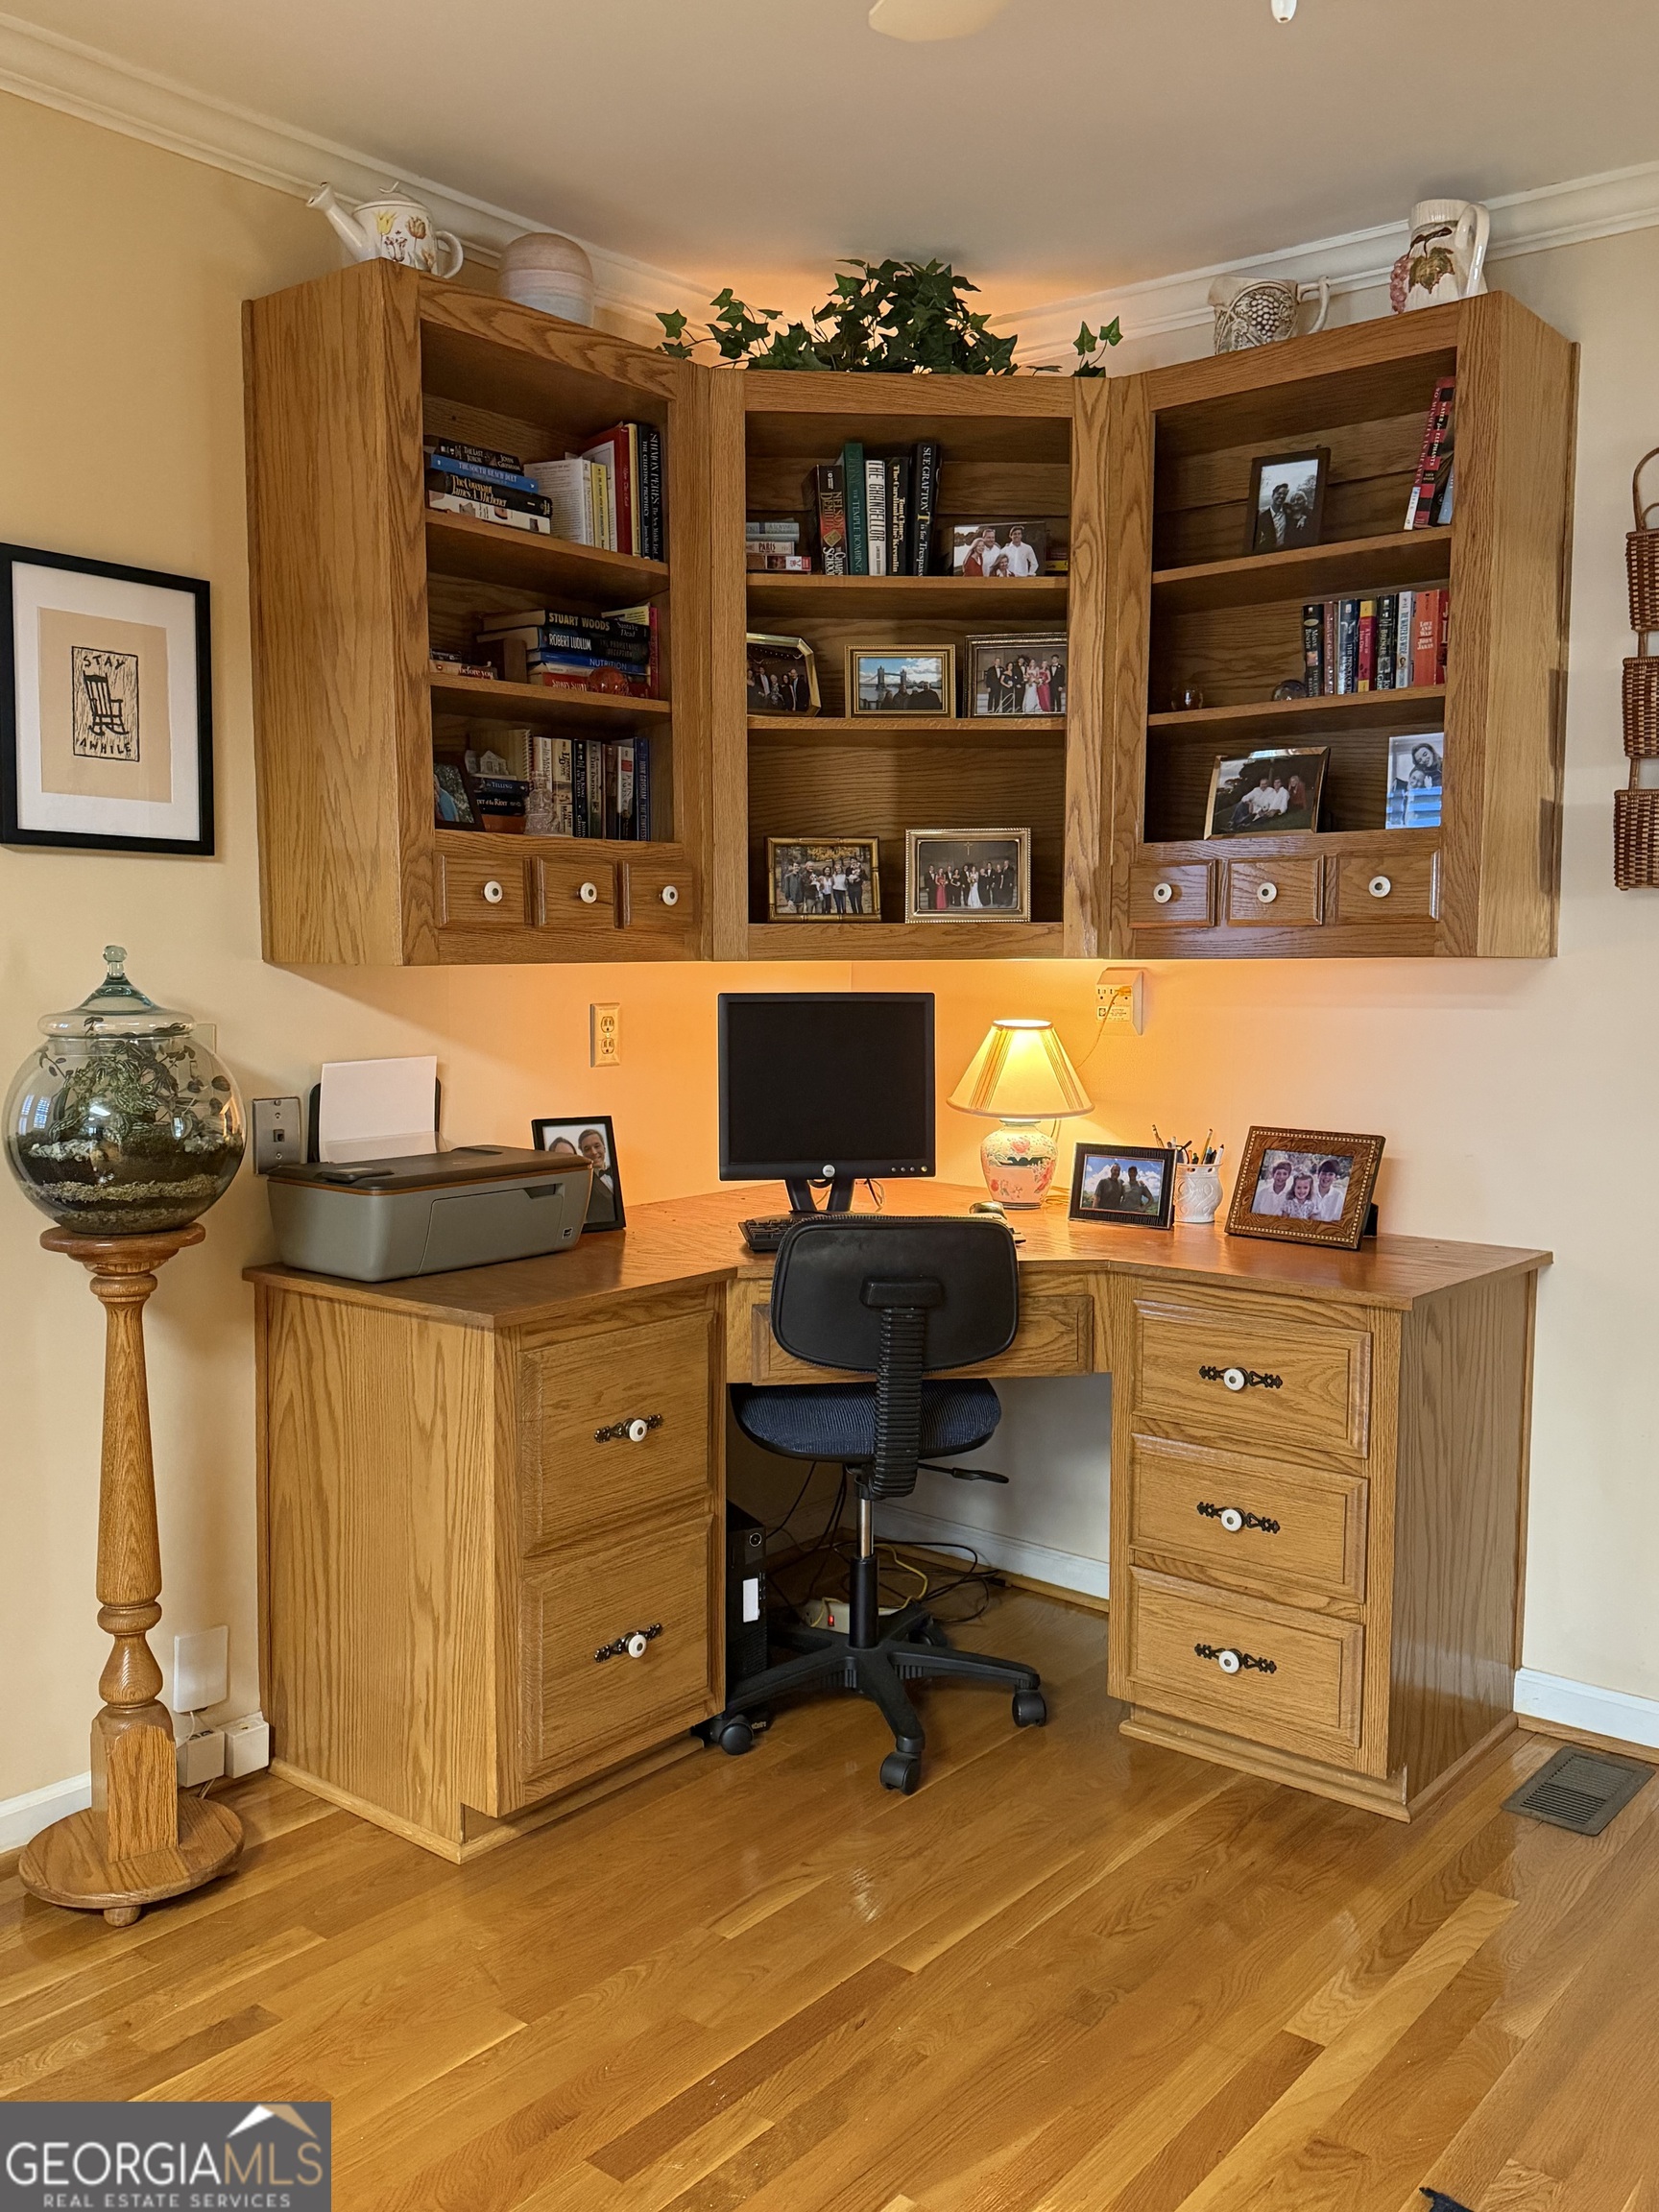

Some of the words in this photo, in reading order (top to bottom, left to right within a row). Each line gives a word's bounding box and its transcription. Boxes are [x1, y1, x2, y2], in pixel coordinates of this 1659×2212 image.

[1438, 401, 1447, 422] WATER
[472, 448, 484, 457] LAST
[649, 433, 659, 470] SHIMON
[922, 447, 931, 466] SUE
[1430, 432, 1440, 467] ELEPHANTS
[500, 455, 515, 464] JOHN
[1415, 452, 1427, 484] HEAVEN
[459, 462, 469, 470] THE
[469, 464, 487, 474] SOUTH
[488, 468, 505, 480] BEACH
[505, 472, 517, 482] DIET
[868, 462, 883, 479] THE
[451, 474, 465, 488] The
[465, 477, 493, 493] Covenant
[651, 473, 660, 505] PERES
[920, 466, 930, 511] GRAFTON
[451, 486, 472, 499] James
[479, 493, 507, 507] Michener
[832, 492, 845, 532] NELSON
[869, 483, 885, 541] CHANCELLOR
[918, 513, 931, 524] T
[758, 543, 776, 553] PARIS
[549, 613, 578, 627] STUART
[581, 616, 611, 632] WOODS
[1400, 618, 1408, 636] WATER
[549, 634, 570, 648] ROBERT
[570, 636, 591, 651] LUDLUM
[620, 629, 636, 637] Dead
[83, 655, 125, 670] STAY
[589, 659, 627, 671] NUTRITION
[459, 666, 480, 677] before
[481, 669, 493, 680] you
[79, 737, 132, 755] AWHILE
